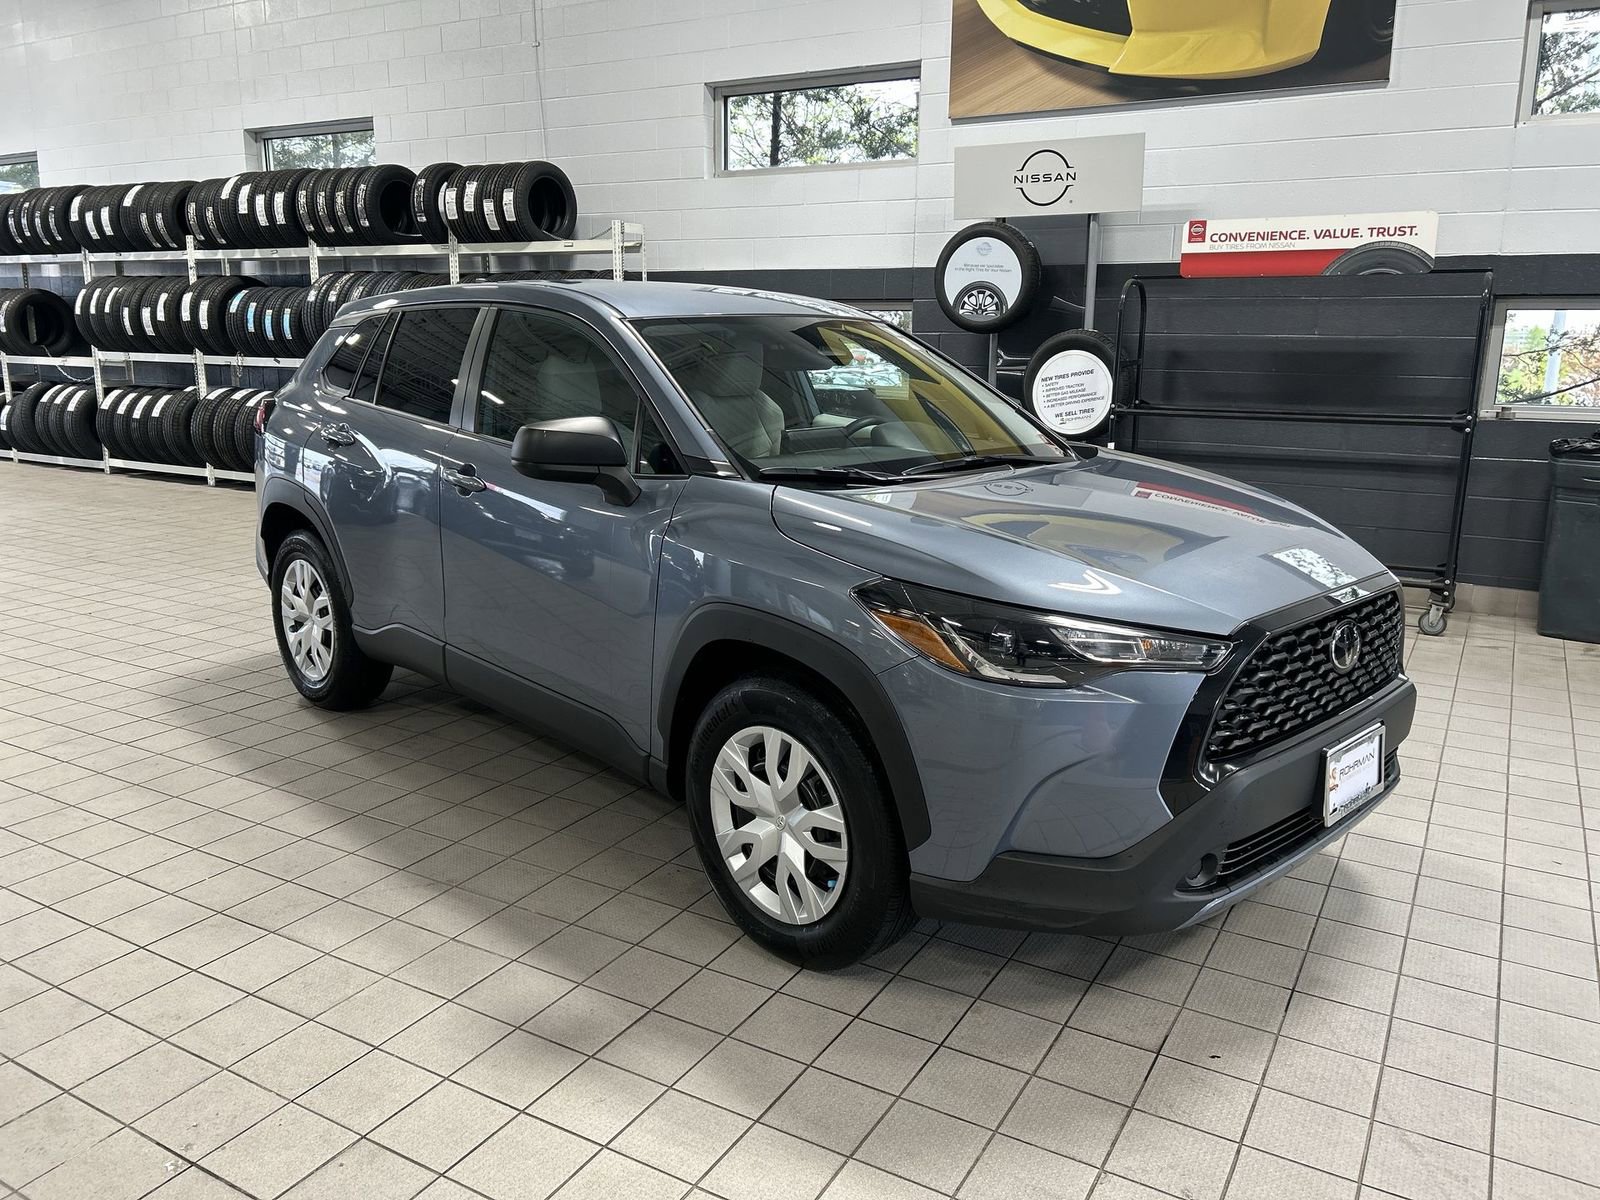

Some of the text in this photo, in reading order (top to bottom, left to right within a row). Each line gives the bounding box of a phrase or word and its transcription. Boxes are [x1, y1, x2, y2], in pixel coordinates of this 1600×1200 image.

[1013, 172, 1077, 184] NISSAN
[1209, 225, 1418, 243] CONVENIENCE. VALUE. TRUST.
[1070, 369, 1095, 377] PROVIDE
[1339, 751, 1375, 778] ROHRMAN
